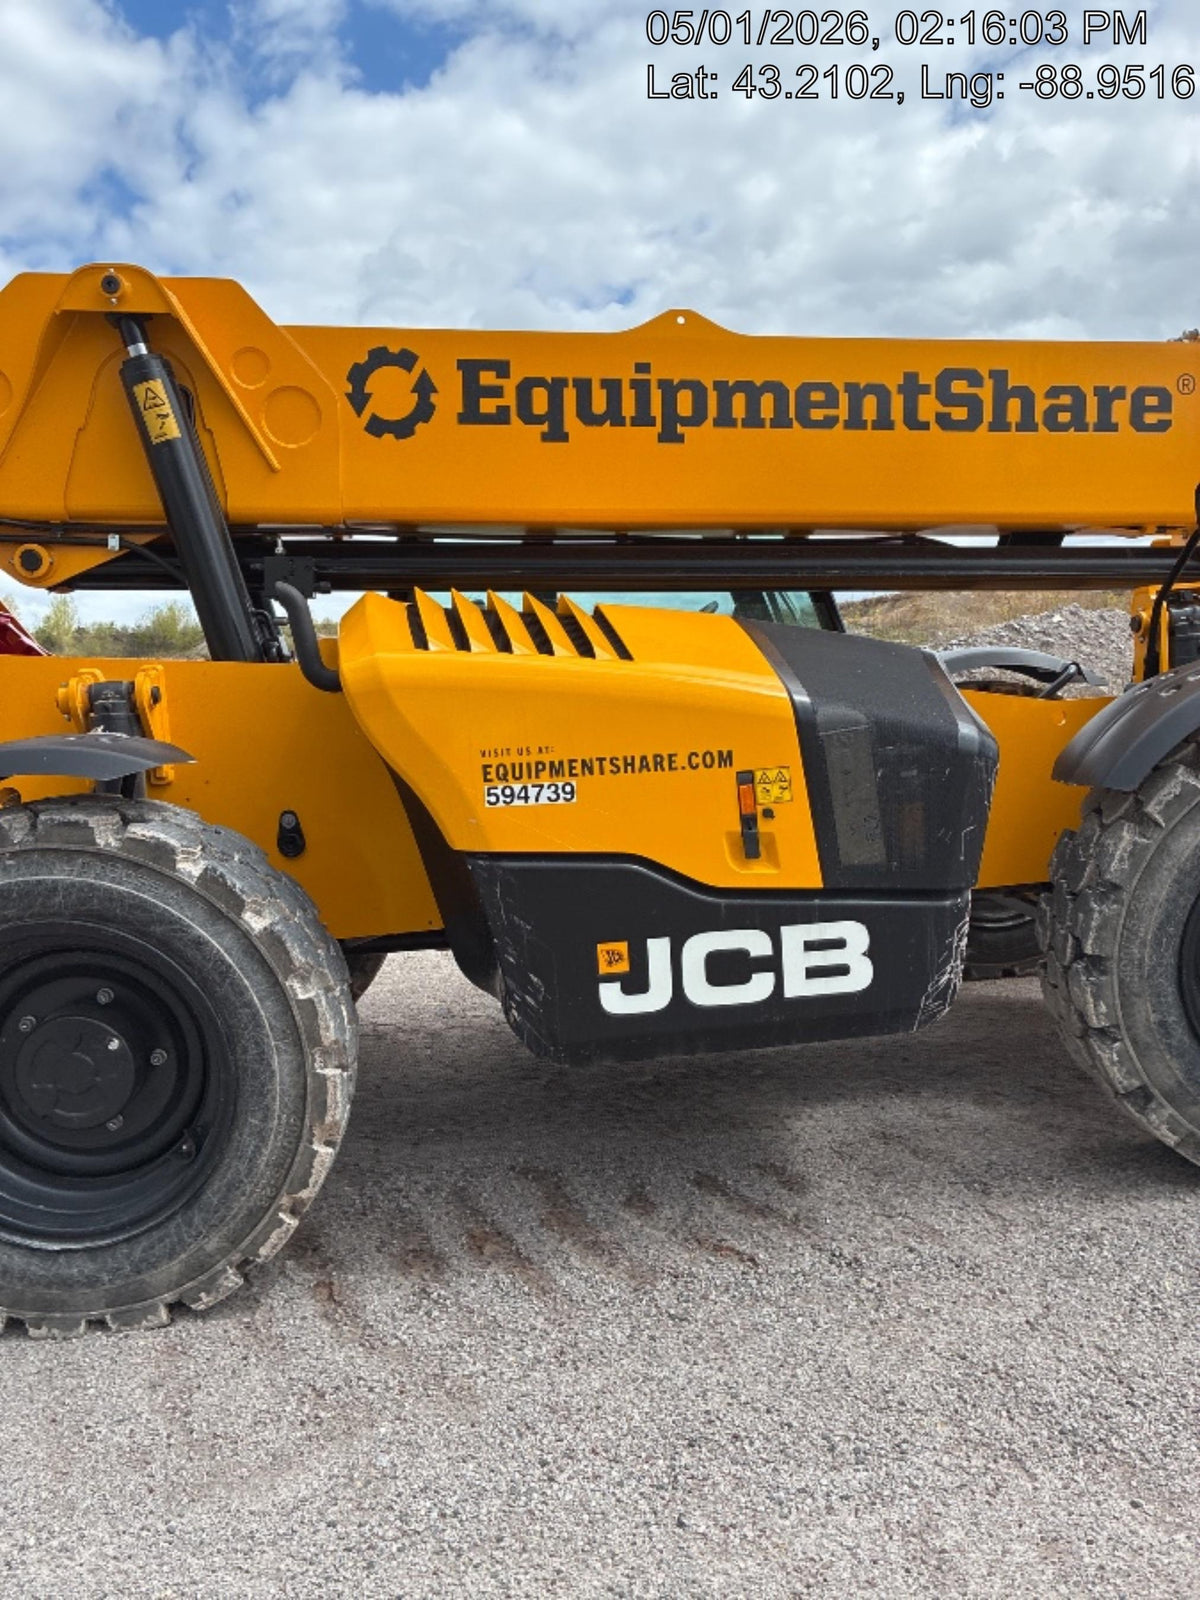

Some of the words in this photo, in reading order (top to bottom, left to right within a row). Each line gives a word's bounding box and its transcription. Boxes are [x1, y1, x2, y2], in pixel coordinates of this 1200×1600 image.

[480, 748, 511, 758] VISIT
[517, 746, 531, 756] US
[481, 750, 734, 783] EQUIPMENTSHARE.COM
[485, 781, 576, 806] 594739
[598, 920, 874, 1014] JCB
